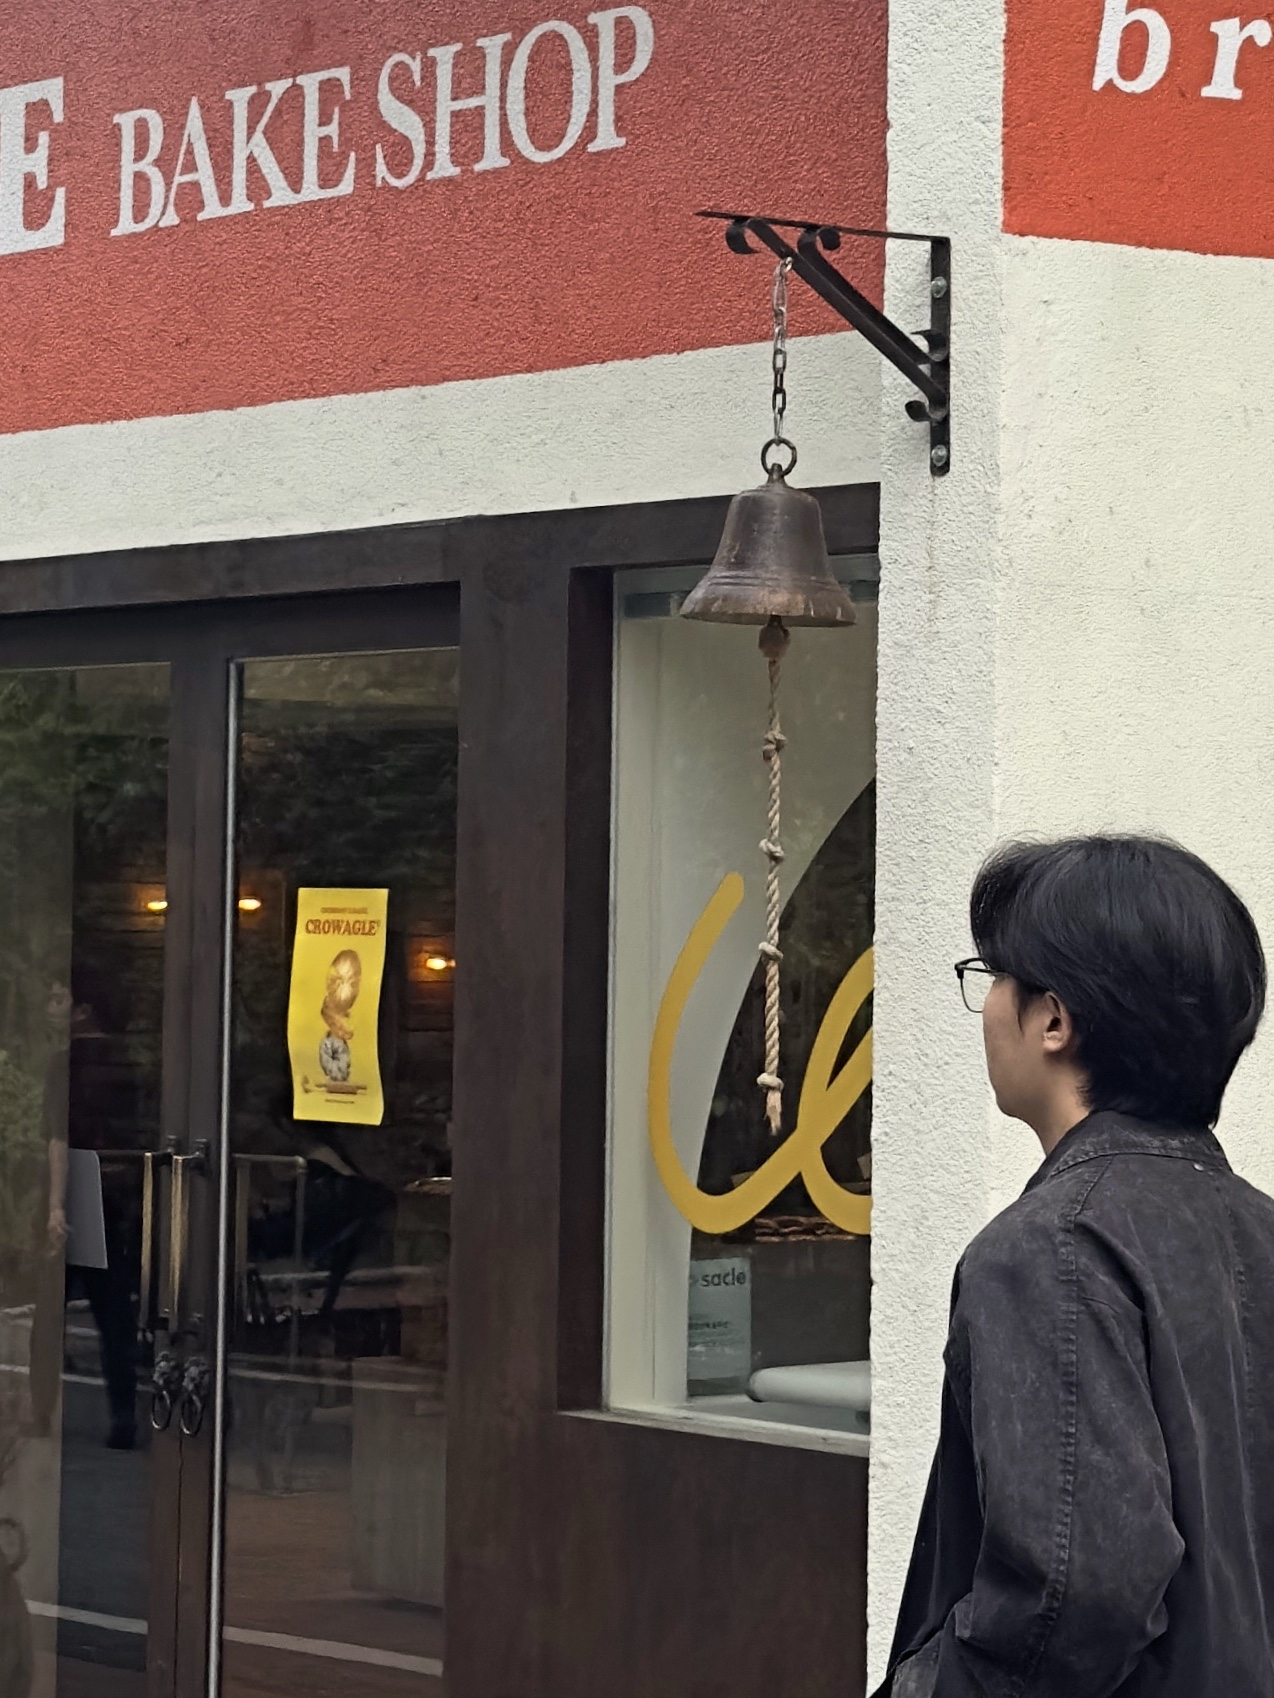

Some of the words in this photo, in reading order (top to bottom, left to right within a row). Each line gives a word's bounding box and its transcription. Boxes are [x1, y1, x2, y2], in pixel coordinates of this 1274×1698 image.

[109, 65, 357, 238] BAKE
[374, 3, 656, 190] SHOP
[305, 919, 380, 937] CROWAGLE
